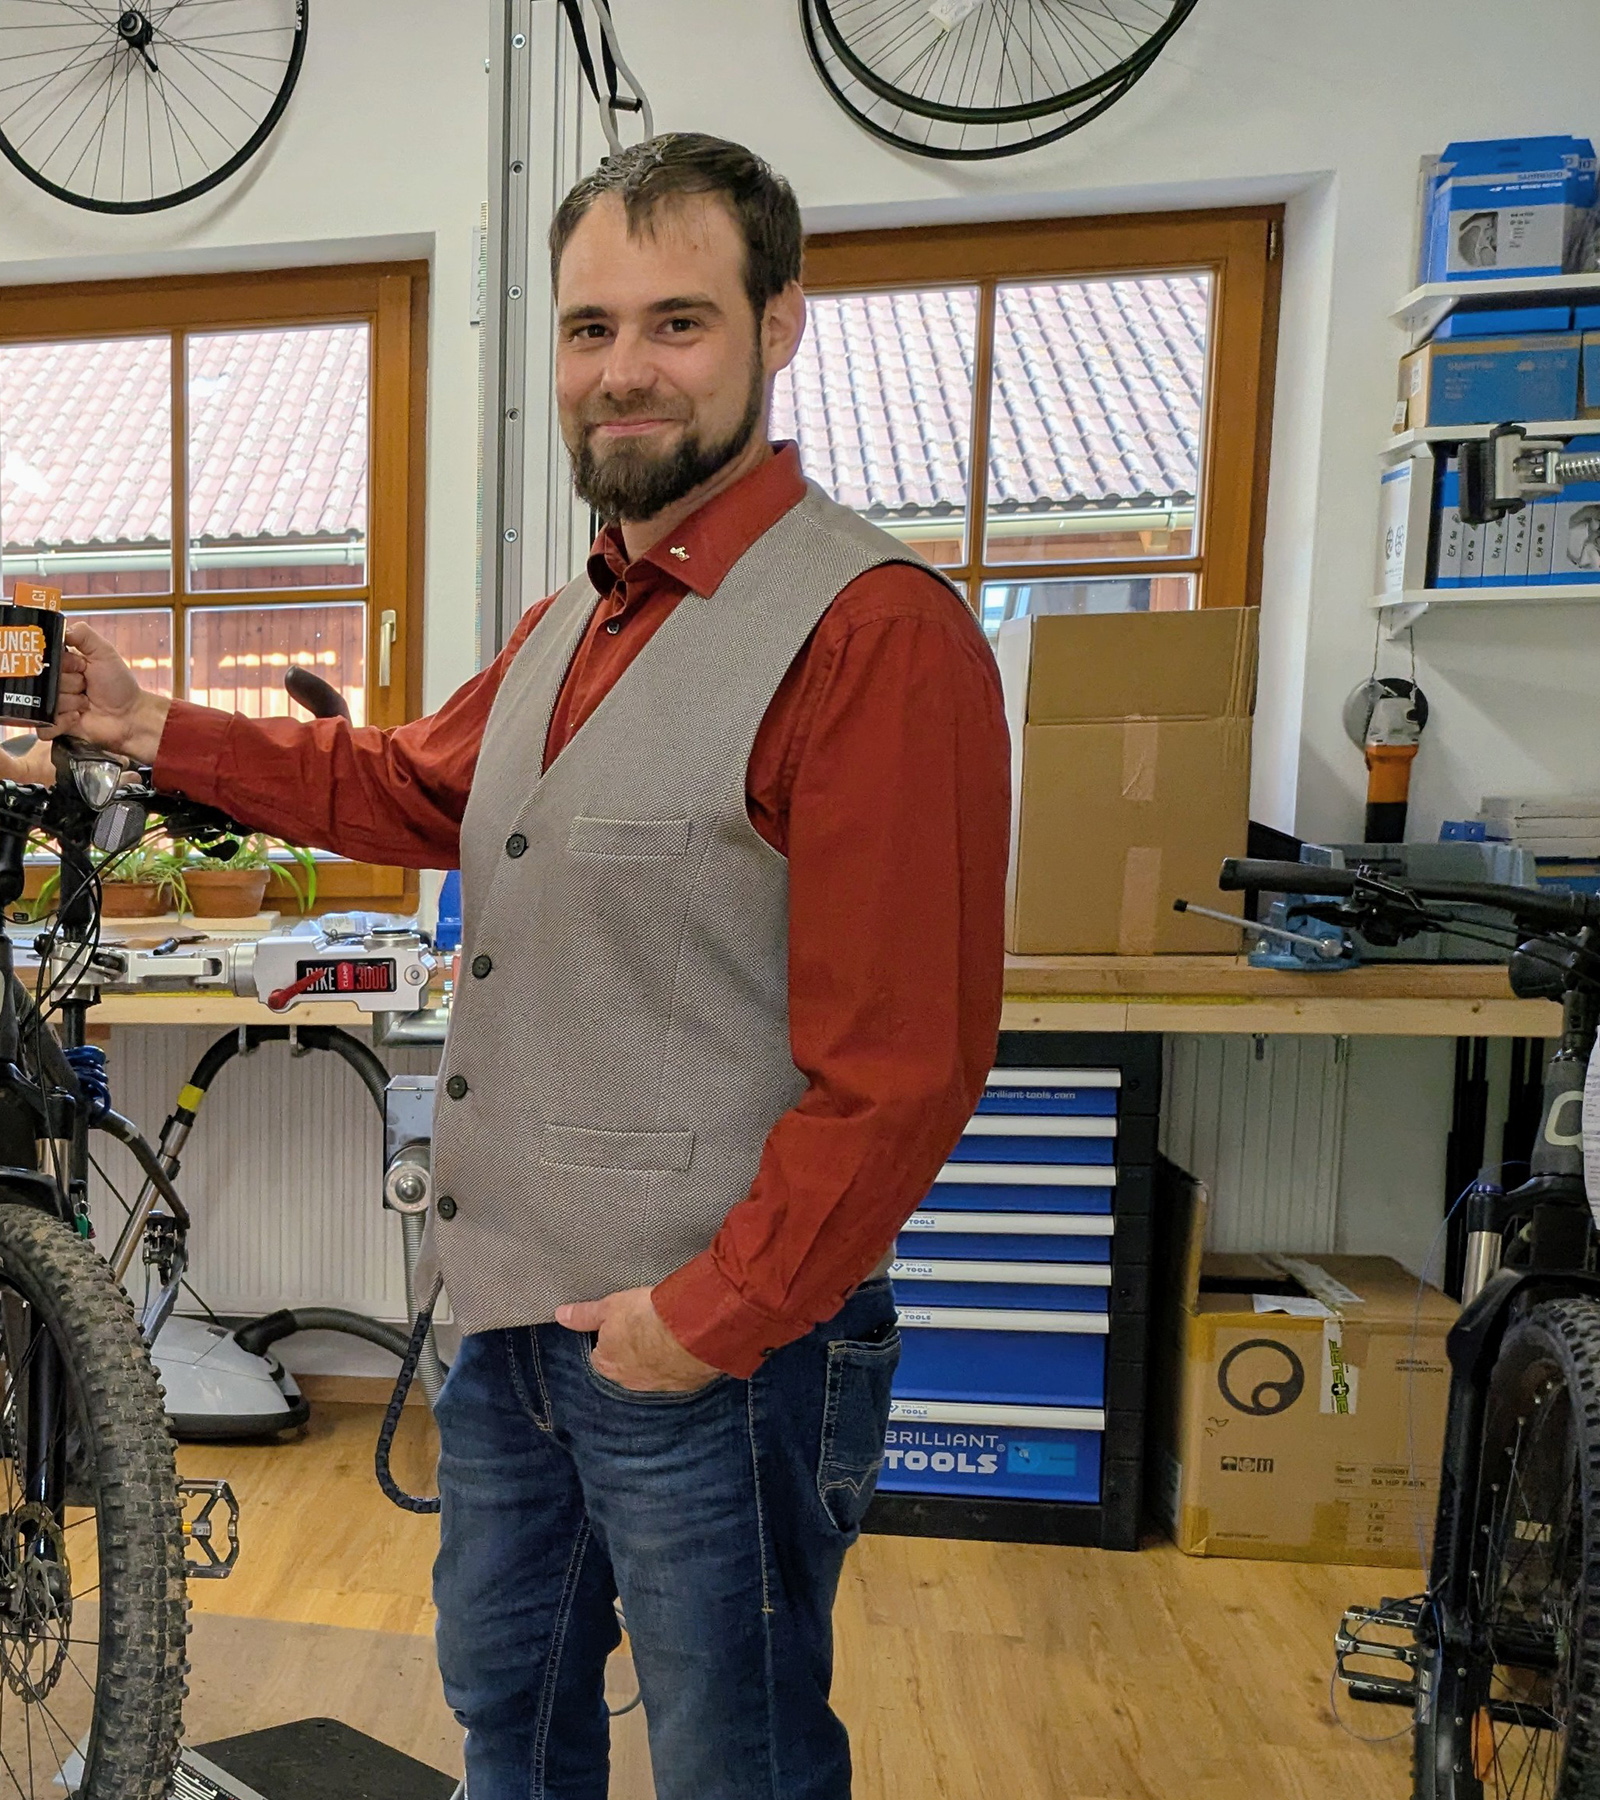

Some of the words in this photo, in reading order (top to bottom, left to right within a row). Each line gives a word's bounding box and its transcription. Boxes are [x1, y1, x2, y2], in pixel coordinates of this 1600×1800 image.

[355, 966, 388, 990] 3000
[886, 1431, 999, 1449] BRILLIANT
[886, 1450, 998, 1474] TOOLS
